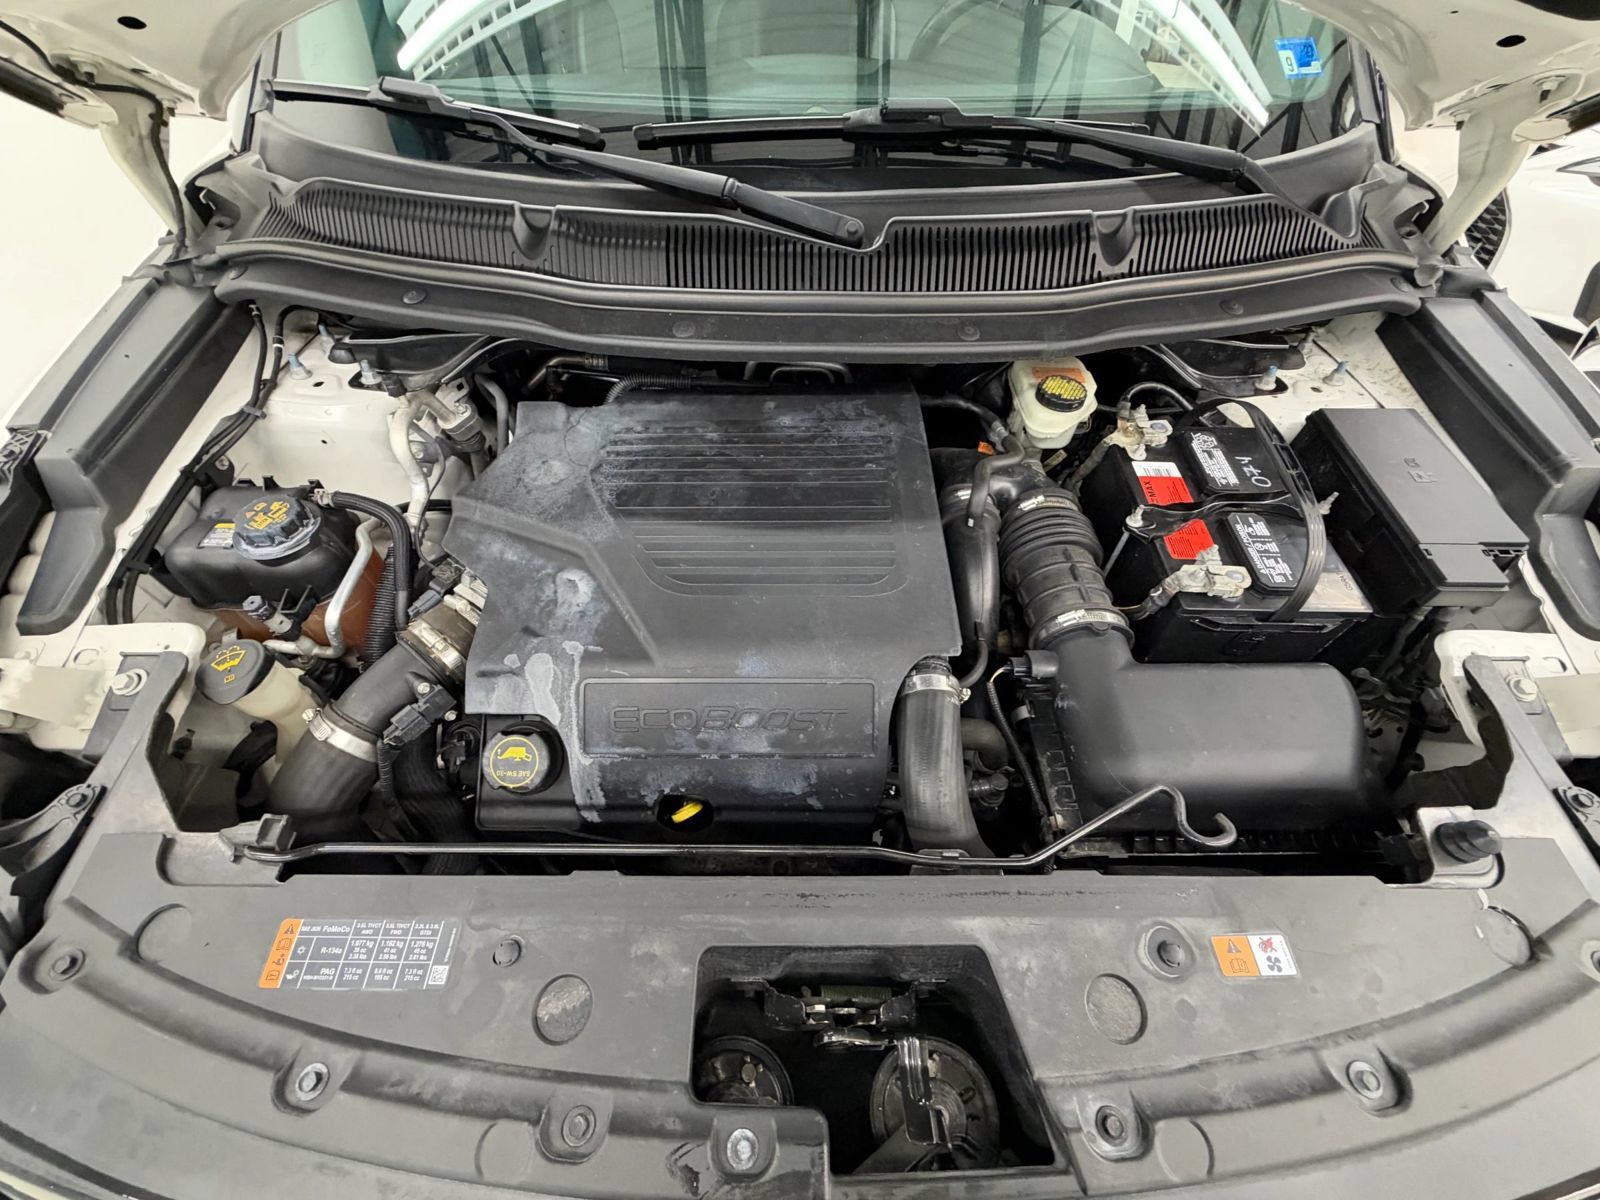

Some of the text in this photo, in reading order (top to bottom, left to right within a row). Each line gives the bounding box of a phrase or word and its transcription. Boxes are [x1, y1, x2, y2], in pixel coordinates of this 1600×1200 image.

[1286, 56, 1294, 72] 9
[1142, 480, 1158, 500] MAX
[366, 940, 374, 948] kg
[397, 940, 404, 949] kg
[426, 940, 433, 949] kg
